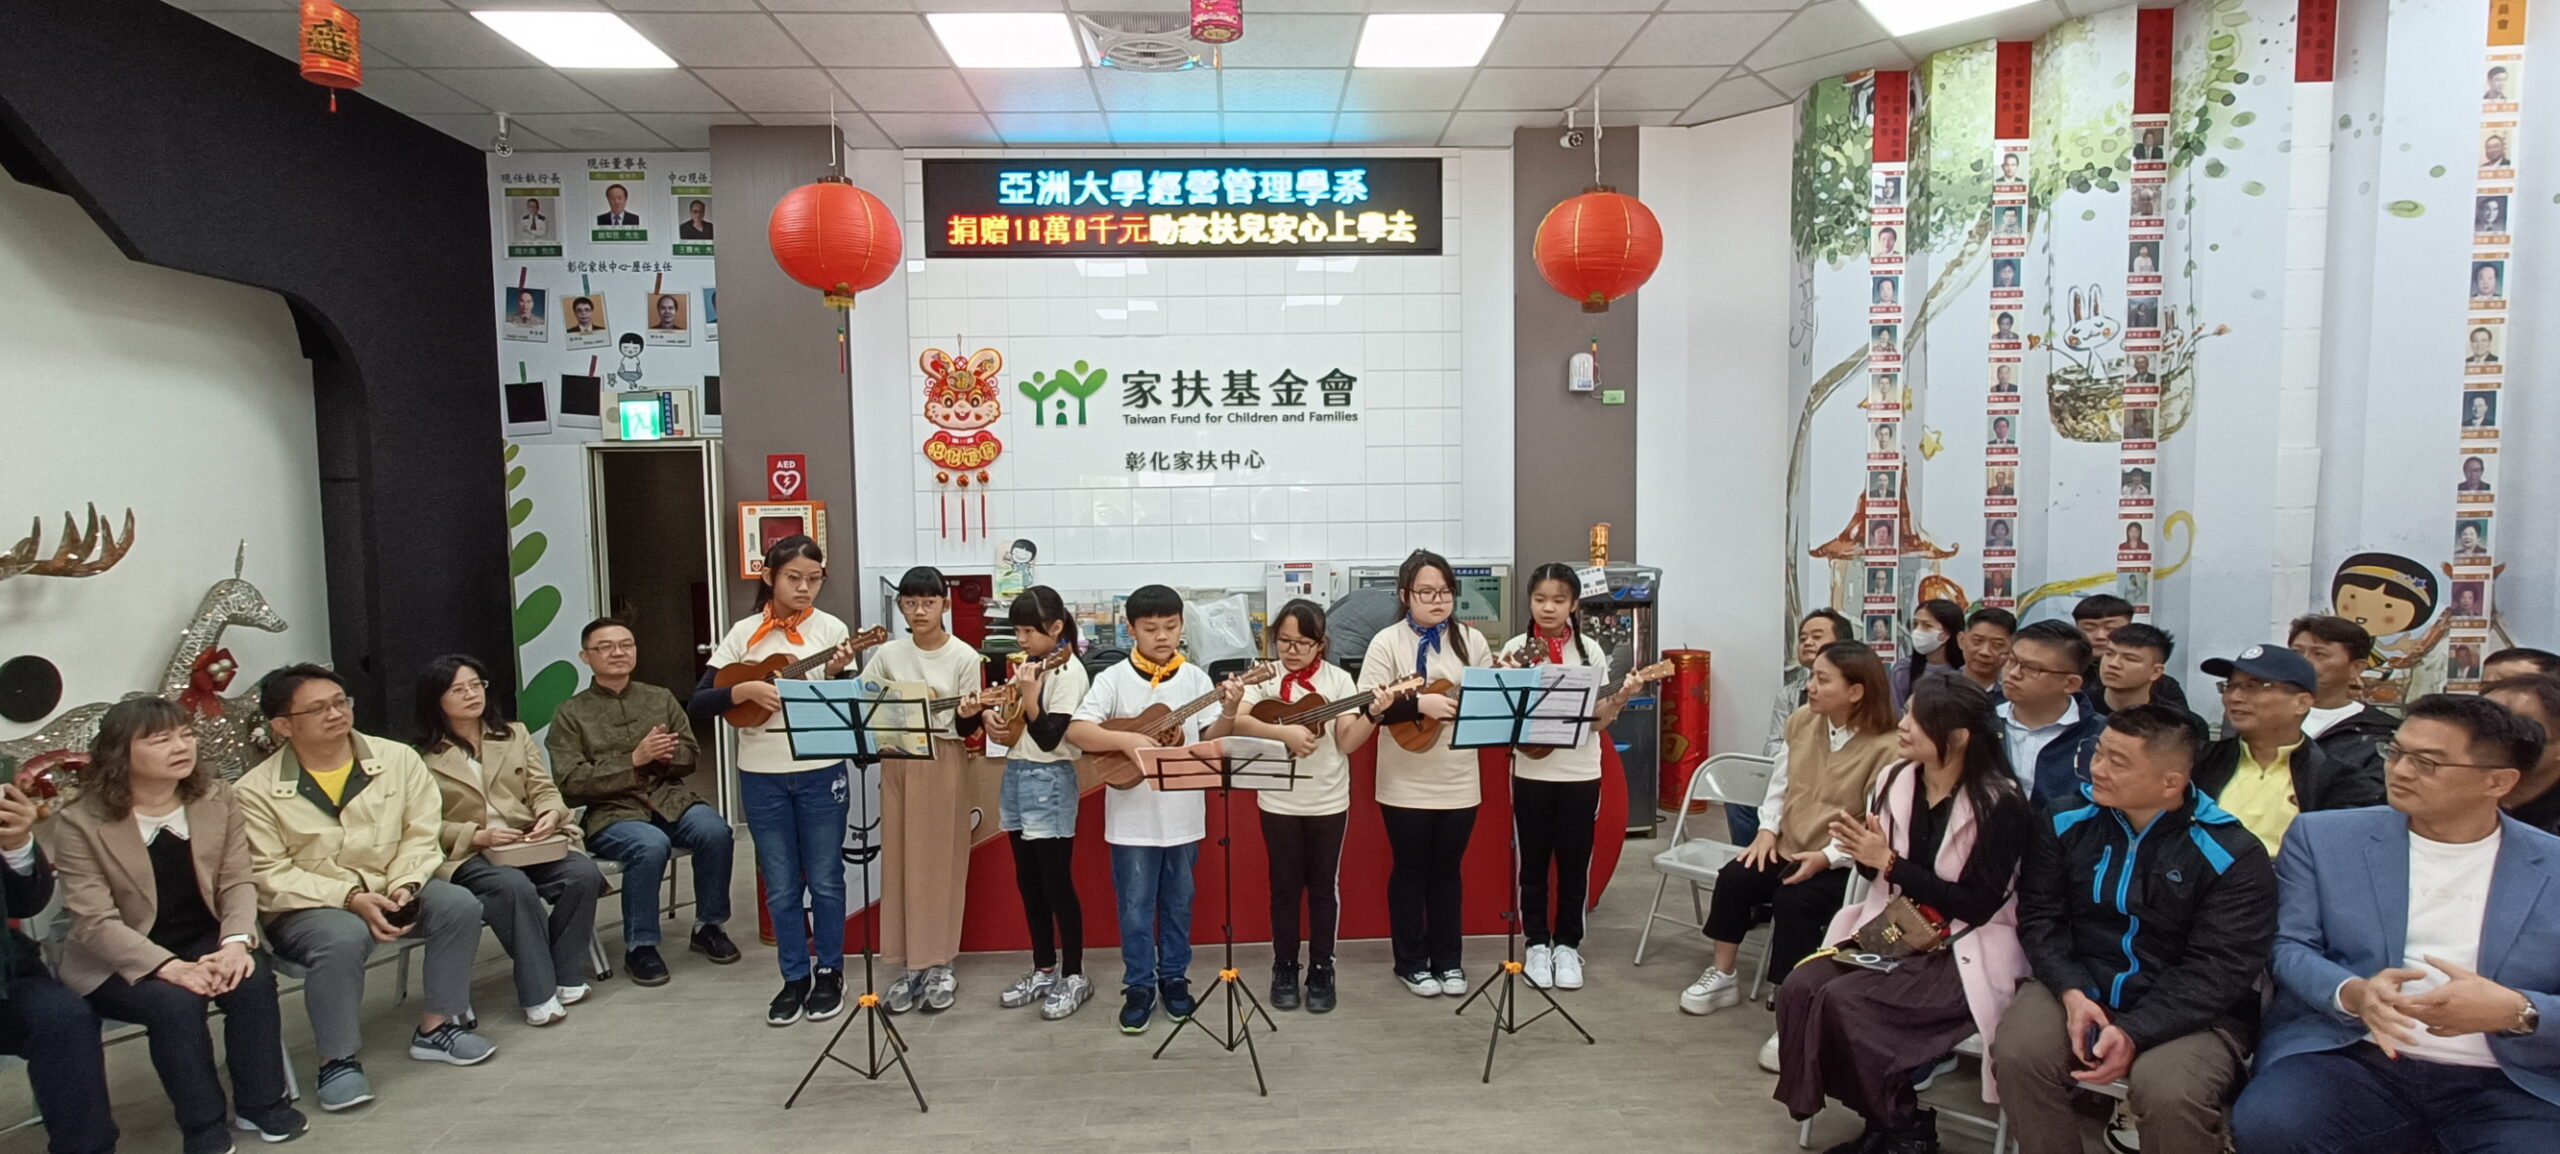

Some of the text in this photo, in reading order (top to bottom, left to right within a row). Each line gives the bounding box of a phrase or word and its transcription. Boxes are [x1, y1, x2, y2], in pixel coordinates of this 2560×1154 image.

[587, 157, 648, 170] 現任董事長
[500, 172, 561, 185] 現任執行長
[667, 171, 713, 185] 中心現任
[998, 168, 1369, 207] 亞洲大學經營管理學系
[947, 209, 1418, 245] 捐贈18萬8千元助家扶兒安心上學去
[1122, 367, 1358, 409] 家扶基金會
[1122, 411, 1359, 425] Taiwan Fund for Children and Families
[776, 460, 796, 469] AED
[1125, 449, 1266, 472] 彰化家扶中心
